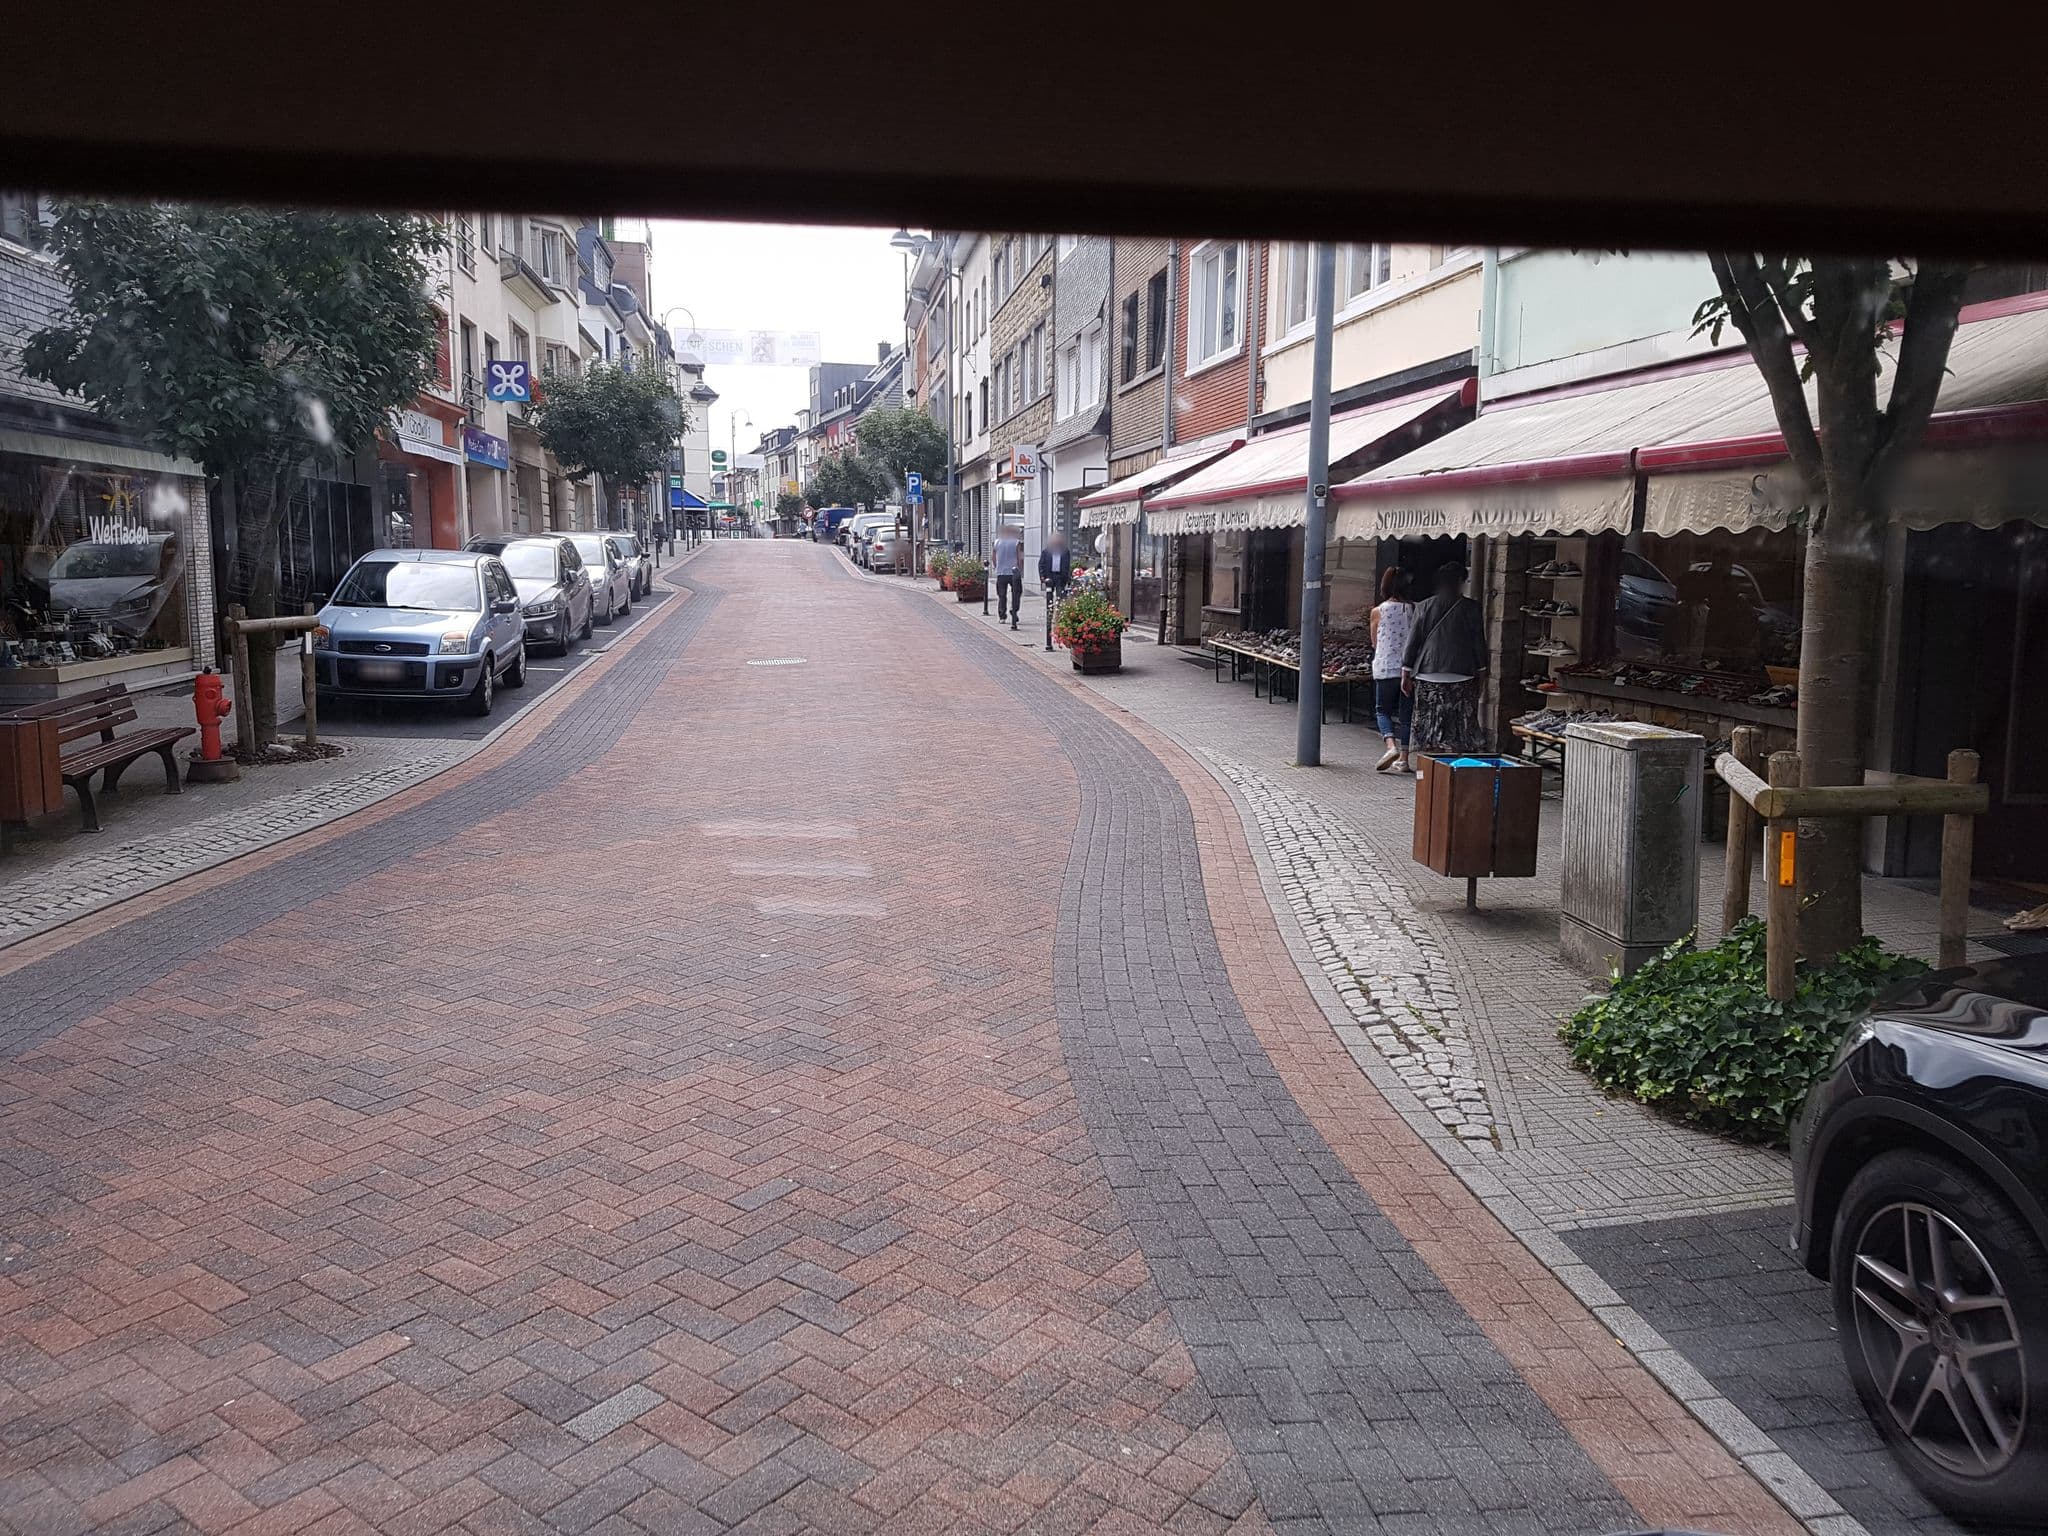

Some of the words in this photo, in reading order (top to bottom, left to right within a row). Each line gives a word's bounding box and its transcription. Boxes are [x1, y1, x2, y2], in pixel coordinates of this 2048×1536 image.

[1015, 464, 1036, 474] ING
[908, 476, 919, 493] P
[1376, 508, 1447, 531] Schuhhaus
[89, 515, 149, 545] Weltladen
